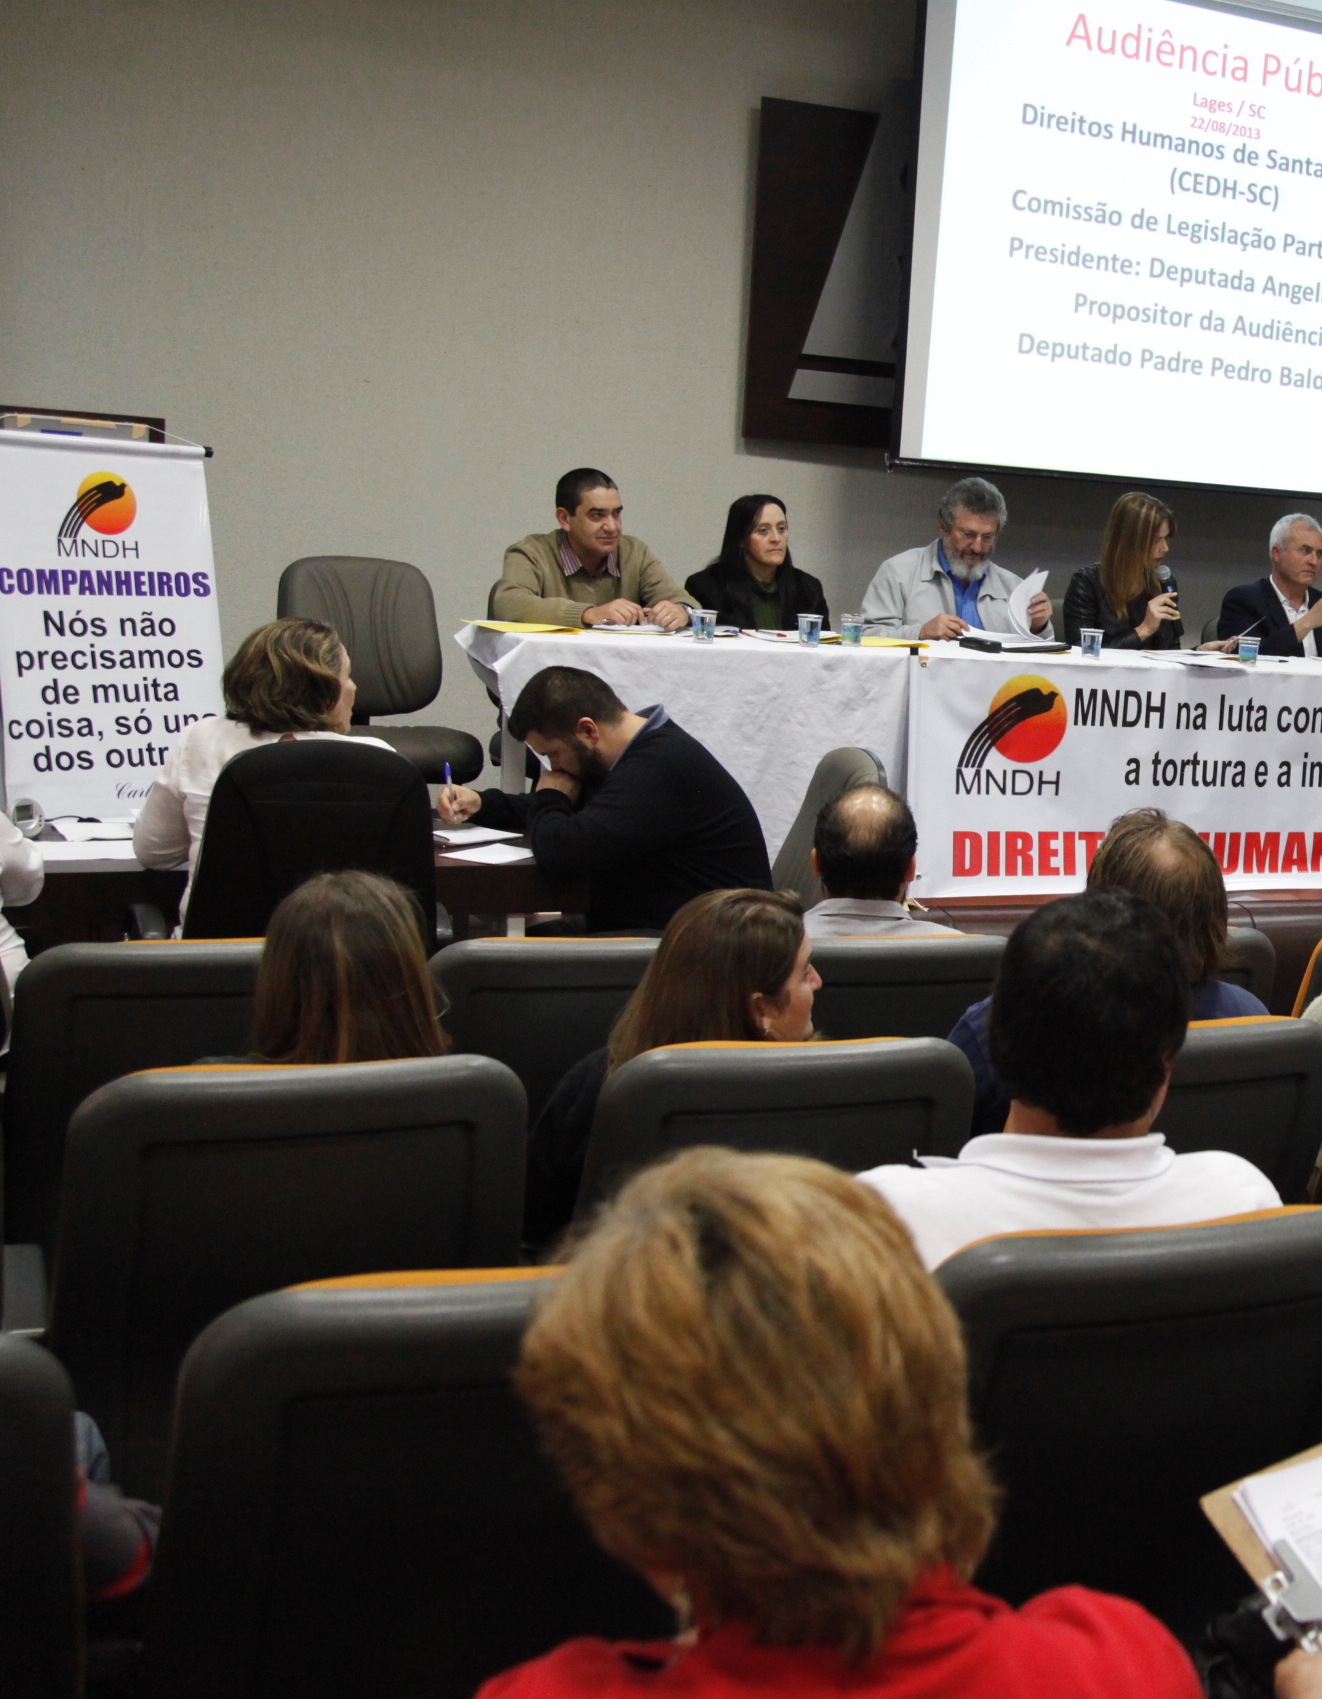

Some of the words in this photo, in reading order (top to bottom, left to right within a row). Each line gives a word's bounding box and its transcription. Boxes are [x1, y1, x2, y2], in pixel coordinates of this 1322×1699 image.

[1065, 13, 1249, 82] Audiência
[1193, 92, 1233, 113] Lages
[1248, 103, 1267, 119] SC
[1021, 103, 1114, 140] Direitos
[1121, 121, 1225, 160] Humanos
[1233, 142, 1259, 166] de
[1190, 116, 1261, 140] 22/08/2013
[1170, 167, 1280, 212] (CEDH-SC)
[1011, 189, 1122, 226] Comissão
[1130, 207, 1159, 231] de
[1166, 213, 1276, 251] Legislação
[1008, 236, 1141, 276] Presidente:
[1149, 257, 1255, 292] Deputada
[1074, 292, 1193, 328] Propositor
[1199, 309, 1225, 333] da
[1018, 332, 1132, 366] Deputado
[1140, 348, 1203, 375] Padre
[1211, 357, 1272, 383] Pedro
[57, 538, 139, 559] MNDH
[0, 567, 211, 598] COMPANHEIROS
[43, 610, 107, 637] Nós
[119, 611, 176, 637] não
[16, 643, 203, 677] precisamos
[41, 678, 80, 705] de
[92, 676, 180, 704] muita
[8, 712, 104, 742] coisa,
[115, 708, 152, 736] só
[1073, 688, 1166, 729] MNDH
[1176, 701, 1208, 730] na
[1218, 694, 1268, 732] luta
[33, 745, 95, 772] dos
[106, 742, 169, 769] outr
[1124, 756, 1141, 786] a
[1152, 750, 1246, 787] tortura
[1254, 759, 1268, 788] e
[1277, 759, 1292, 788] a
[115, 781, 155, 800] Carl
[955, 767, 1061, 796] MNDH
[952, 831, 1106, 877] DIREIT
